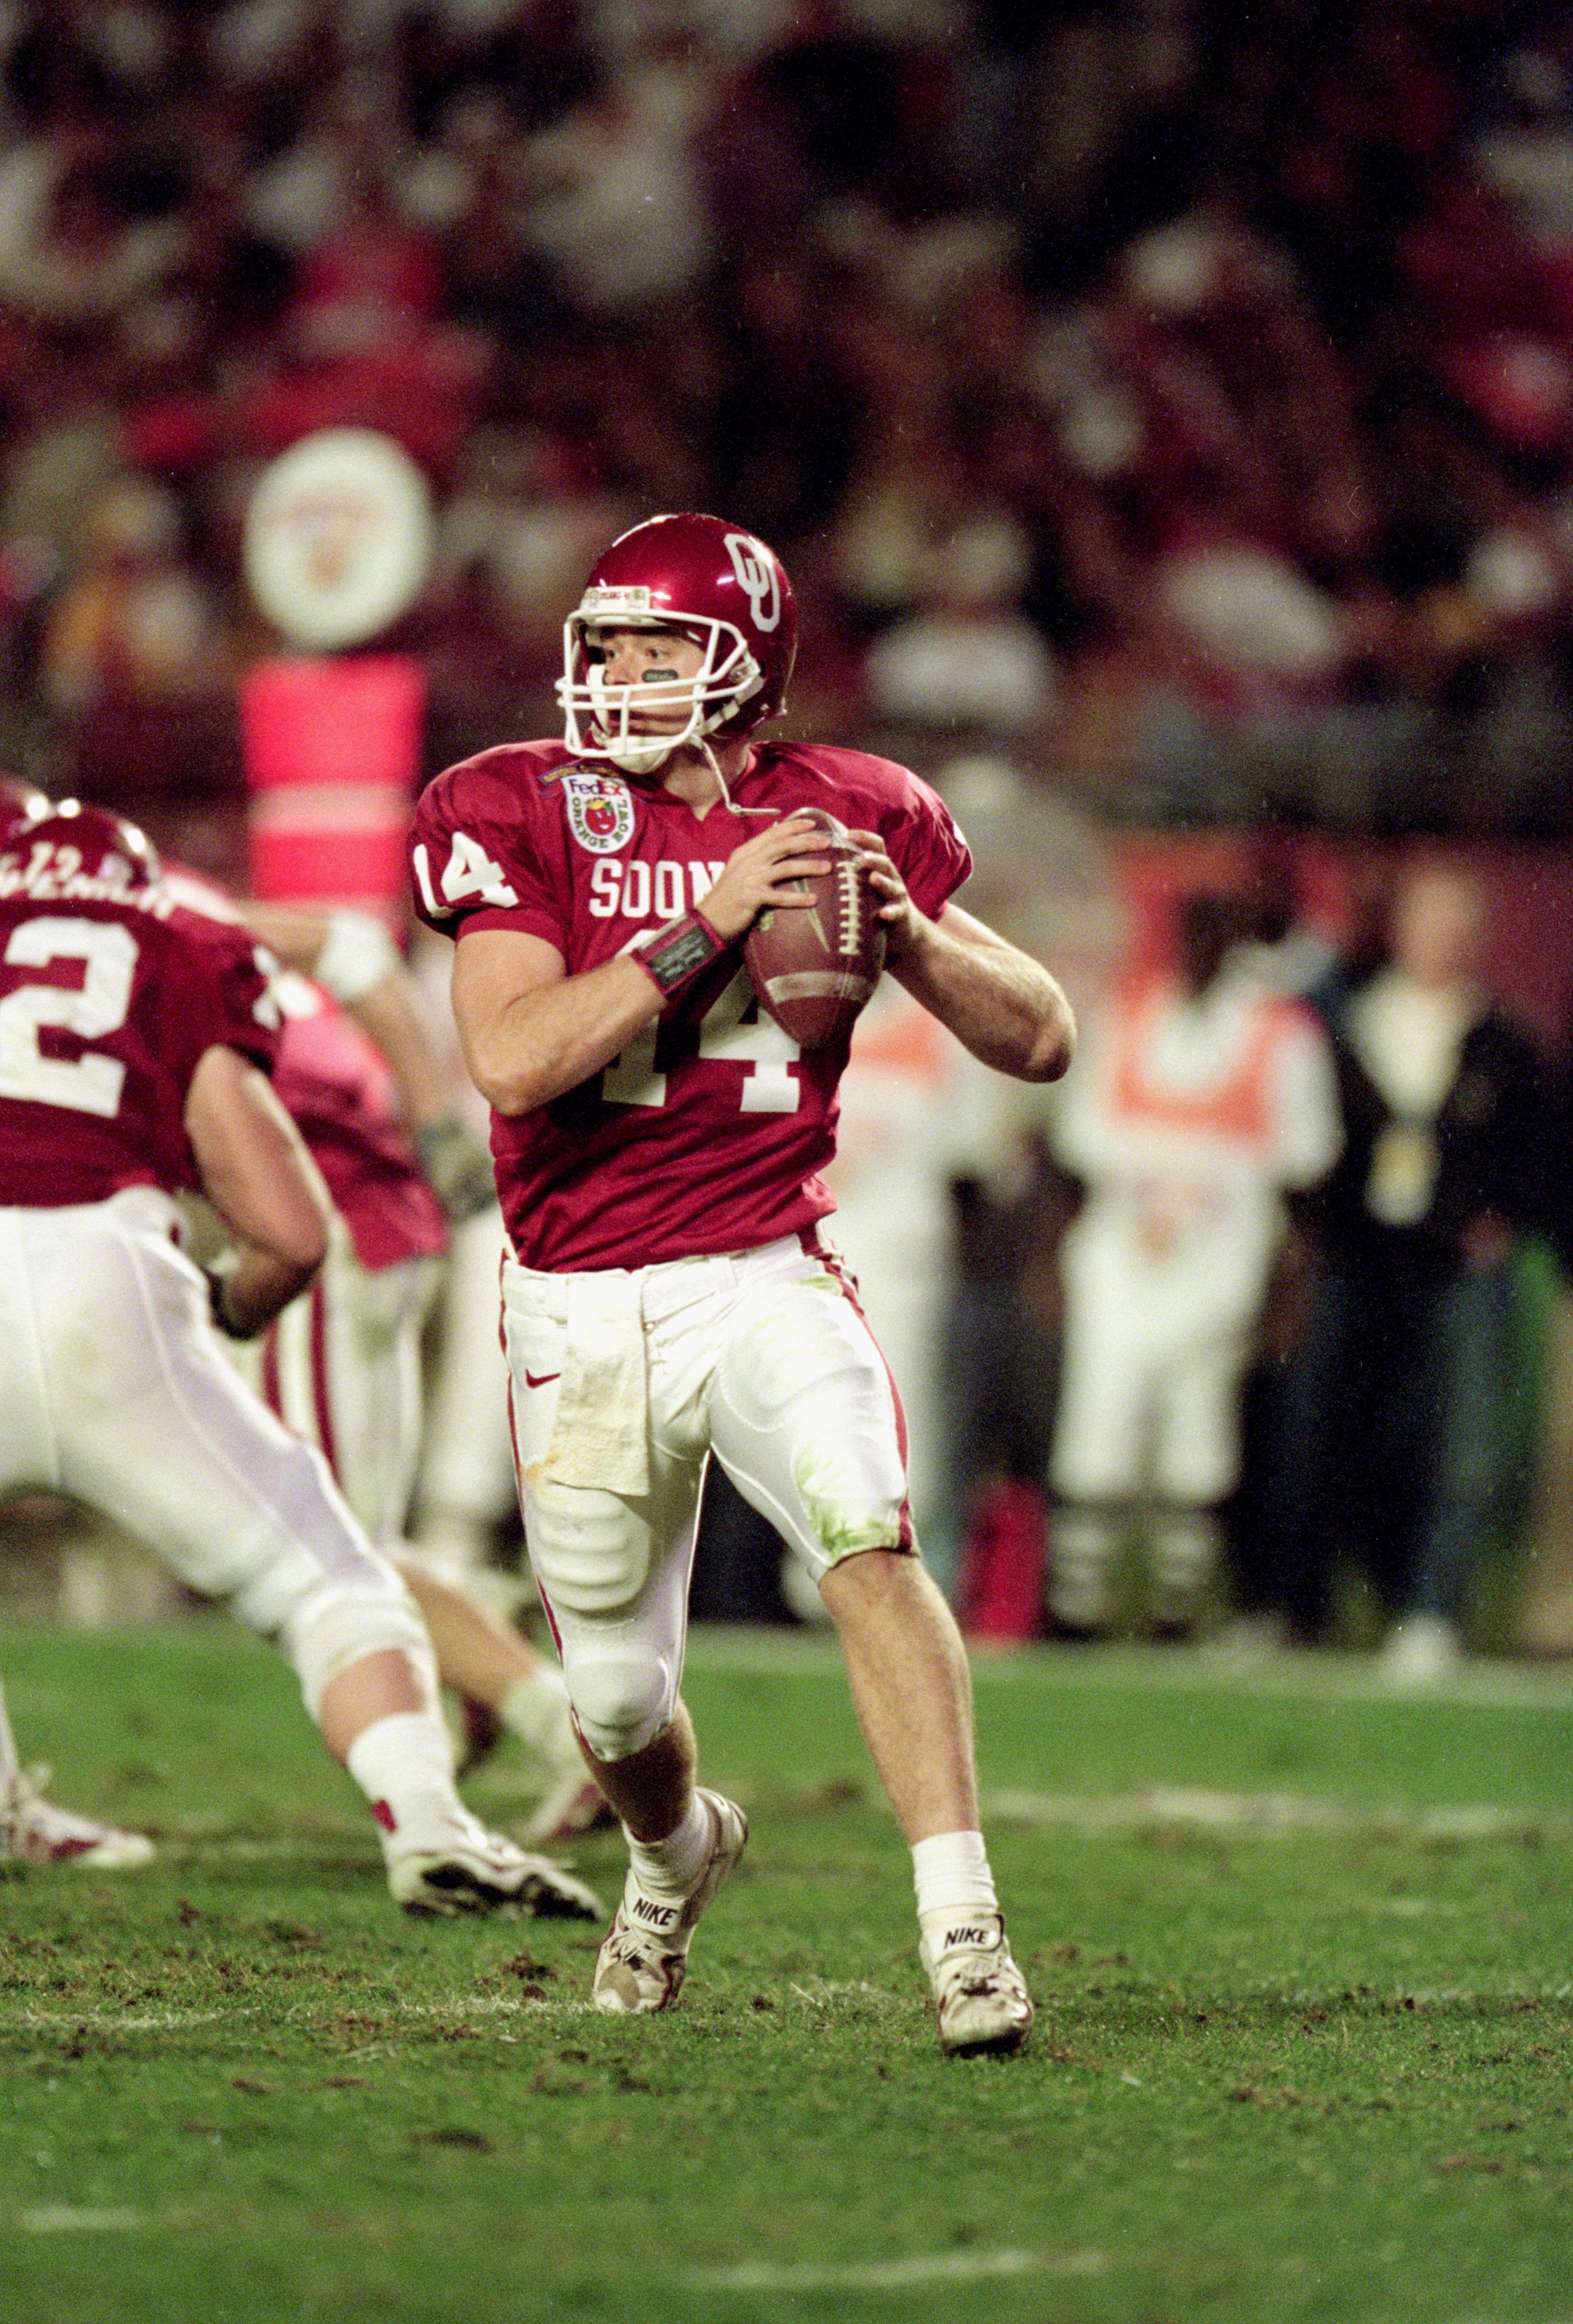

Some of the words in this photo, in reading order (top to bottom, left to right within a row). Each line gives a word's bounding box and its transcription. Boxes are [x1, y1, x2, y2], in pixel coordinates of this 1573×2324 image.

[568, 778, 624, 796] FedEx
[572, 795, 609, 849] ORANGE
[611, 799, 629, 843] BOWL
[412, 831, 520, 919] 14
[602, 929, 801, 1114] 14
[632, 1897, 679, 1926] NIKE
[943, 1927, 989, 1950] NIKE
